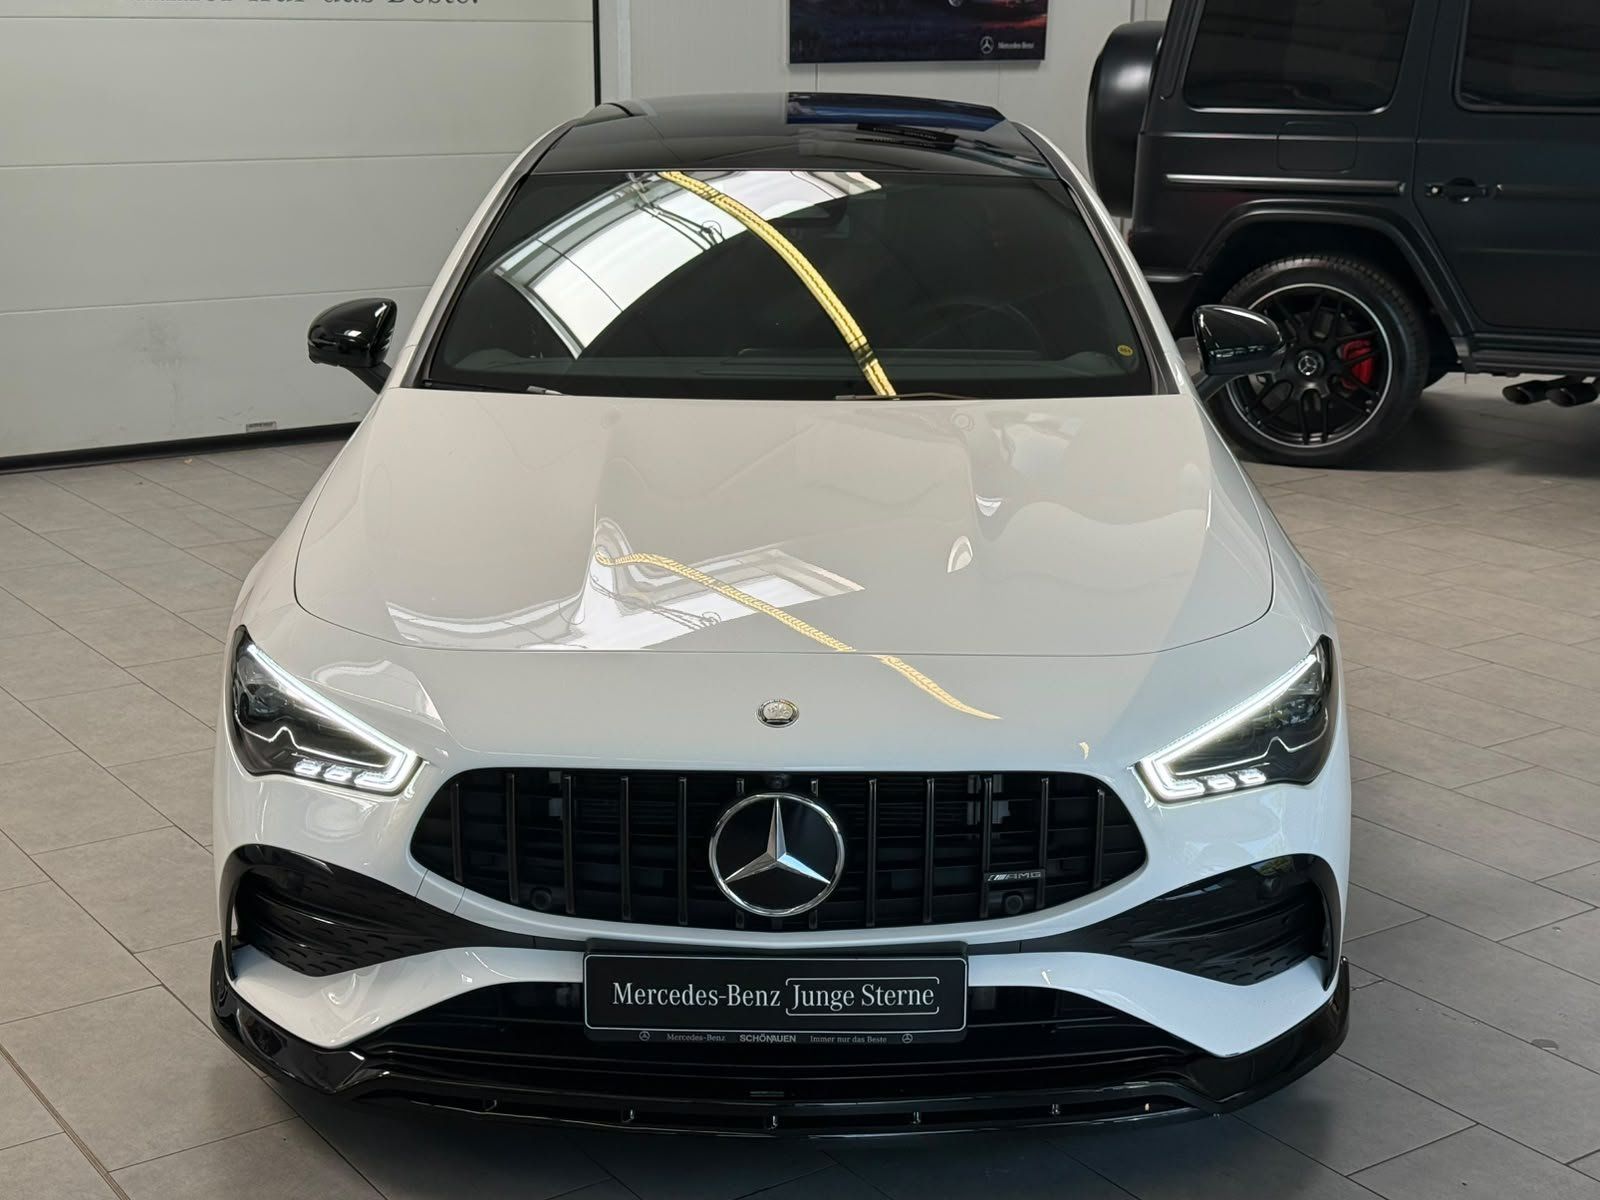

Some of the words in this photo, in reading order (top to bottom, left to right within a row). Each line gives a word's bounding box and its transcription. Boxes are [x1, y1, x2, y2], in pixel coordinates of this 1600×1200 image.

[612, 982, 781, 1007] Mercedes-Benz
[791, 984, 855, 1012] Junge
[861, 983, 934, 1006] Sterne
[666, 1033, 726, 1042] Mercedes-Benz
[739, 1033, 797, 1043] SCHÖNAUEN
[810, 1035, 835, 1043] Immer
[852, 1035, 866, 1043] das
[867, 1035, 888, 1044] Beste
